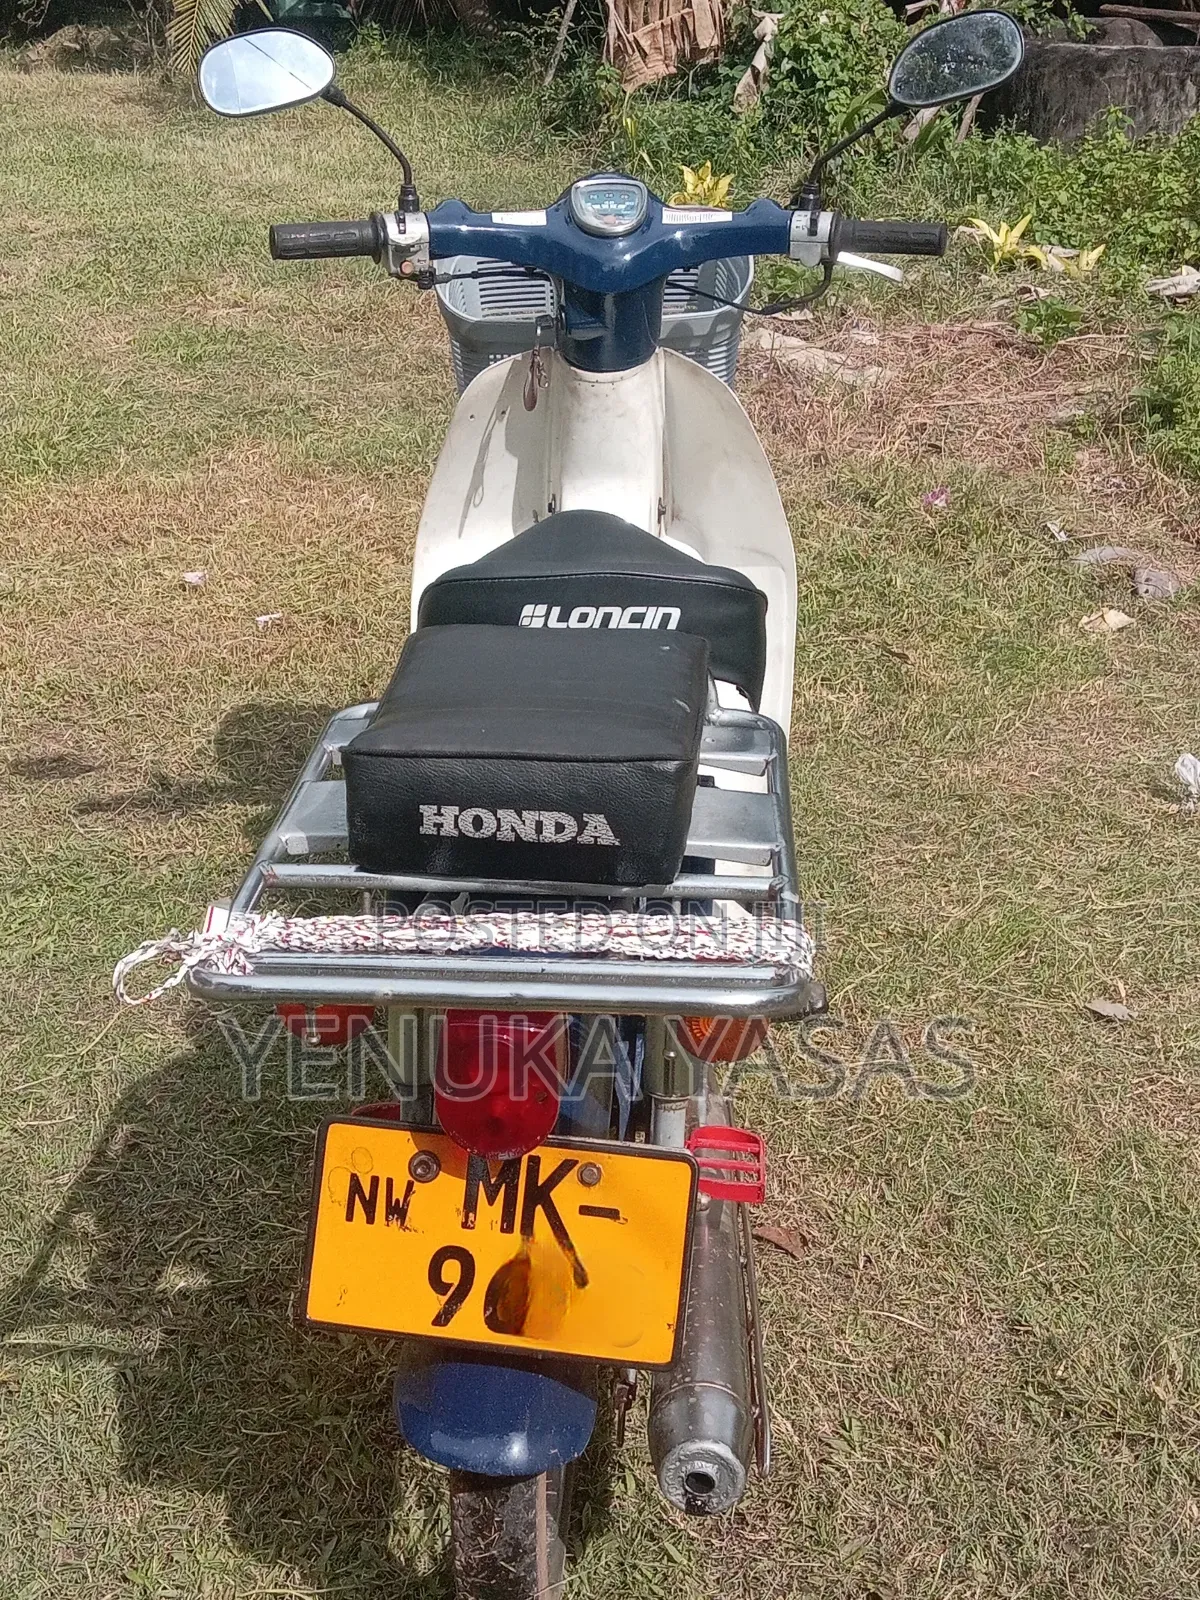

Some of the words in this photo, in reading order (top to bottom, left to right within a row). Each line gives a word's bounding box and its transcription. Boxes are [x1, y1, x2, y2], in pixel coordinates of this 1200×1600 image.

[547, 605, 682, 630] LONCIN
[418, 804, 621, 847] HONDA
[345, 1172, 416, 1228] NW
